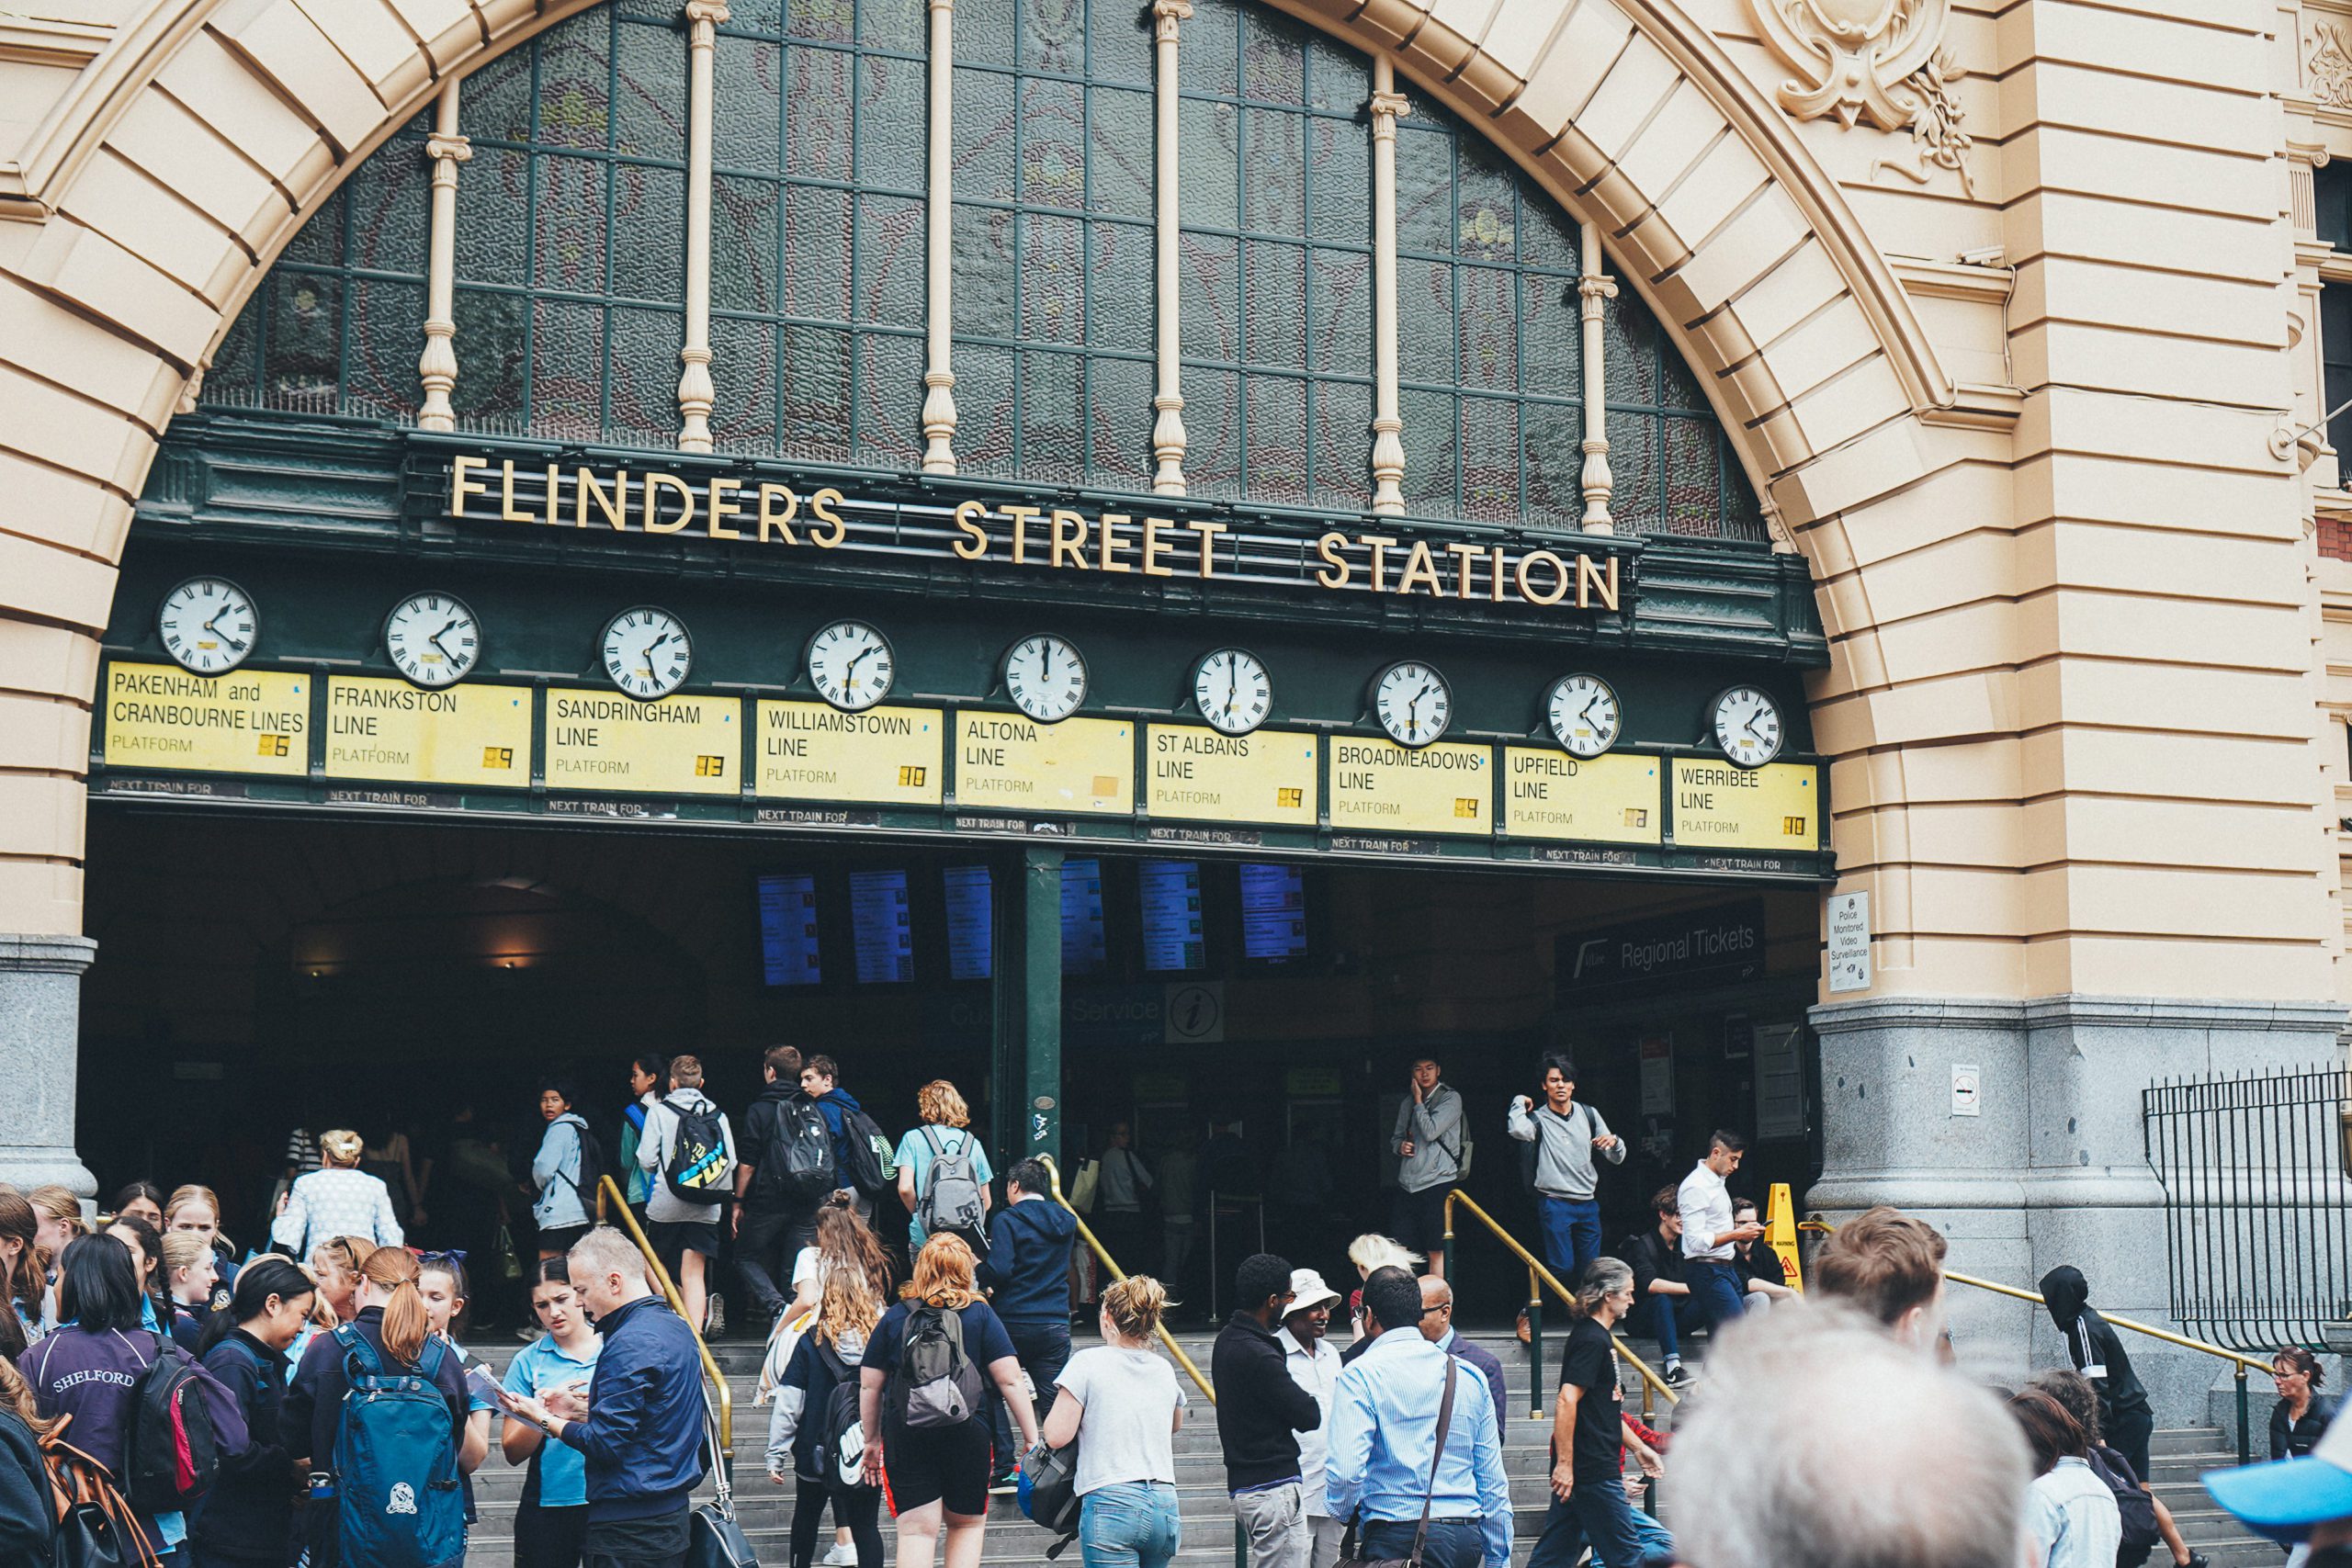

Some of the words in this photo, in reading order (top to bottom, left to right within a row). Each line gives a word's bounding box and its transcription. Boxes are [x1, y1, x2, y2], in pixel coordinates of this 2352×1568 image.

[450, 454, 847, 549] FLINDERS
[950, 500, 1228, 580] STREET
[1314, 532, 1620, 613] STATION
[114, 672, 218, 699] PAKENHAM
[230, 682, 261, 702] and
[334, 687, 458, 713] FRANKSTON
[113, 701, 245, 729] CRANBOURNE
[251, 710, 303, 733] LINES
[557, 699, 701, 725] SANDRINGHAM
[334, 715, 378, 736] LINE
[768, 710, 911, 736] WILLIAMSTOWN
[967, 720, 1037, 742] ALTONA
[111, 735, 193, 752] PLATFORM
[556, 727, 598, 747] LINE
[1157, 734, 1179, 753] ST
[1182, 736, 1250, 757] ALBANS
[767, 737, 808, 757] LINE
[333, 748, 410, 765] PLATFORM
[966, 747, 1005, 766] LINE
[1339, 746, 1479, 771] BROADMEADOWS
[556, 759, 629, 774] PLATFORM
[1157, 761, 1193, 779] LINE
[1514, 756, 1578, 777] UPFIELD
[766, 768, 837, 784] PLATFORM
[1339, 772, 1374, 790] LINE
[1680, 768, 1759, 788] WERRIBEE
[110, 780, 141, 791] NEXT
[147, 782, 184, 794] TRAIN
[187, 783, 211, 795] FOR
[966, 777, 1034, 794] PLATFORM
[1514, 781, 1548, 800] LINE
[330, 791, 361, 802] NEXT
[364, 792, 401, 804] TRAIN
[403, 795, 427, 806] FOR
[1156, 789, 1221, 805] PLATFORM
[1680, 793, 1713, 809] LINE
[549, 801, 579, 812] NEXT
[582, 802, 617, 814] TRAIN
[620, 805, 642, 815] FOR
[758, 809, 786, 820] NEXT
[789, 811, 822, 822] TRAIN
[825, 813, 847, 823] FOR
[1339, 801, 1400, 816] PLATFORM
[956, 818, 976, 829] NEXT
[978, 819, 1004, 829] TRAIN
[1007, 820, 1025, 830] FOR
[1513, 809, 1574, 825] PLATFORM
[1150, 829, 1177, 839] NEXT
[1179, 829, 1209, 841] TRAIN
[1212, 831, 1232, 842] FOR
[1681, 820, 1739, 834] PLATFORM
[1332, 838, 1356, 849] NEXT
[1359, 840, 1388, 852] TRAIN
[1390, 841, 1409, 852] FOR
[1546, 850, 1569, 861] NEXT
[1573, 851, 1600, 862] TRAIN
[1602, 852, 1621, 863] FOR
[1710, 857, 1733, 868] NEXT
[1735, 859, 1762, 869] TRAIN
[1763, 861, 1781, 870] FOR
[1838, 910, 1858, 921] Police
[1834, 922, 1864, 934] Monitored
[1622, 932, 1690, 971] Regional
[1693, 925, 1754, 957] Tickets
[1840, 936, 1858, 946] Video
[1831, 948, 1868, 961] Surveillance
[52, 1369, 135, 1393] SHELFORD
